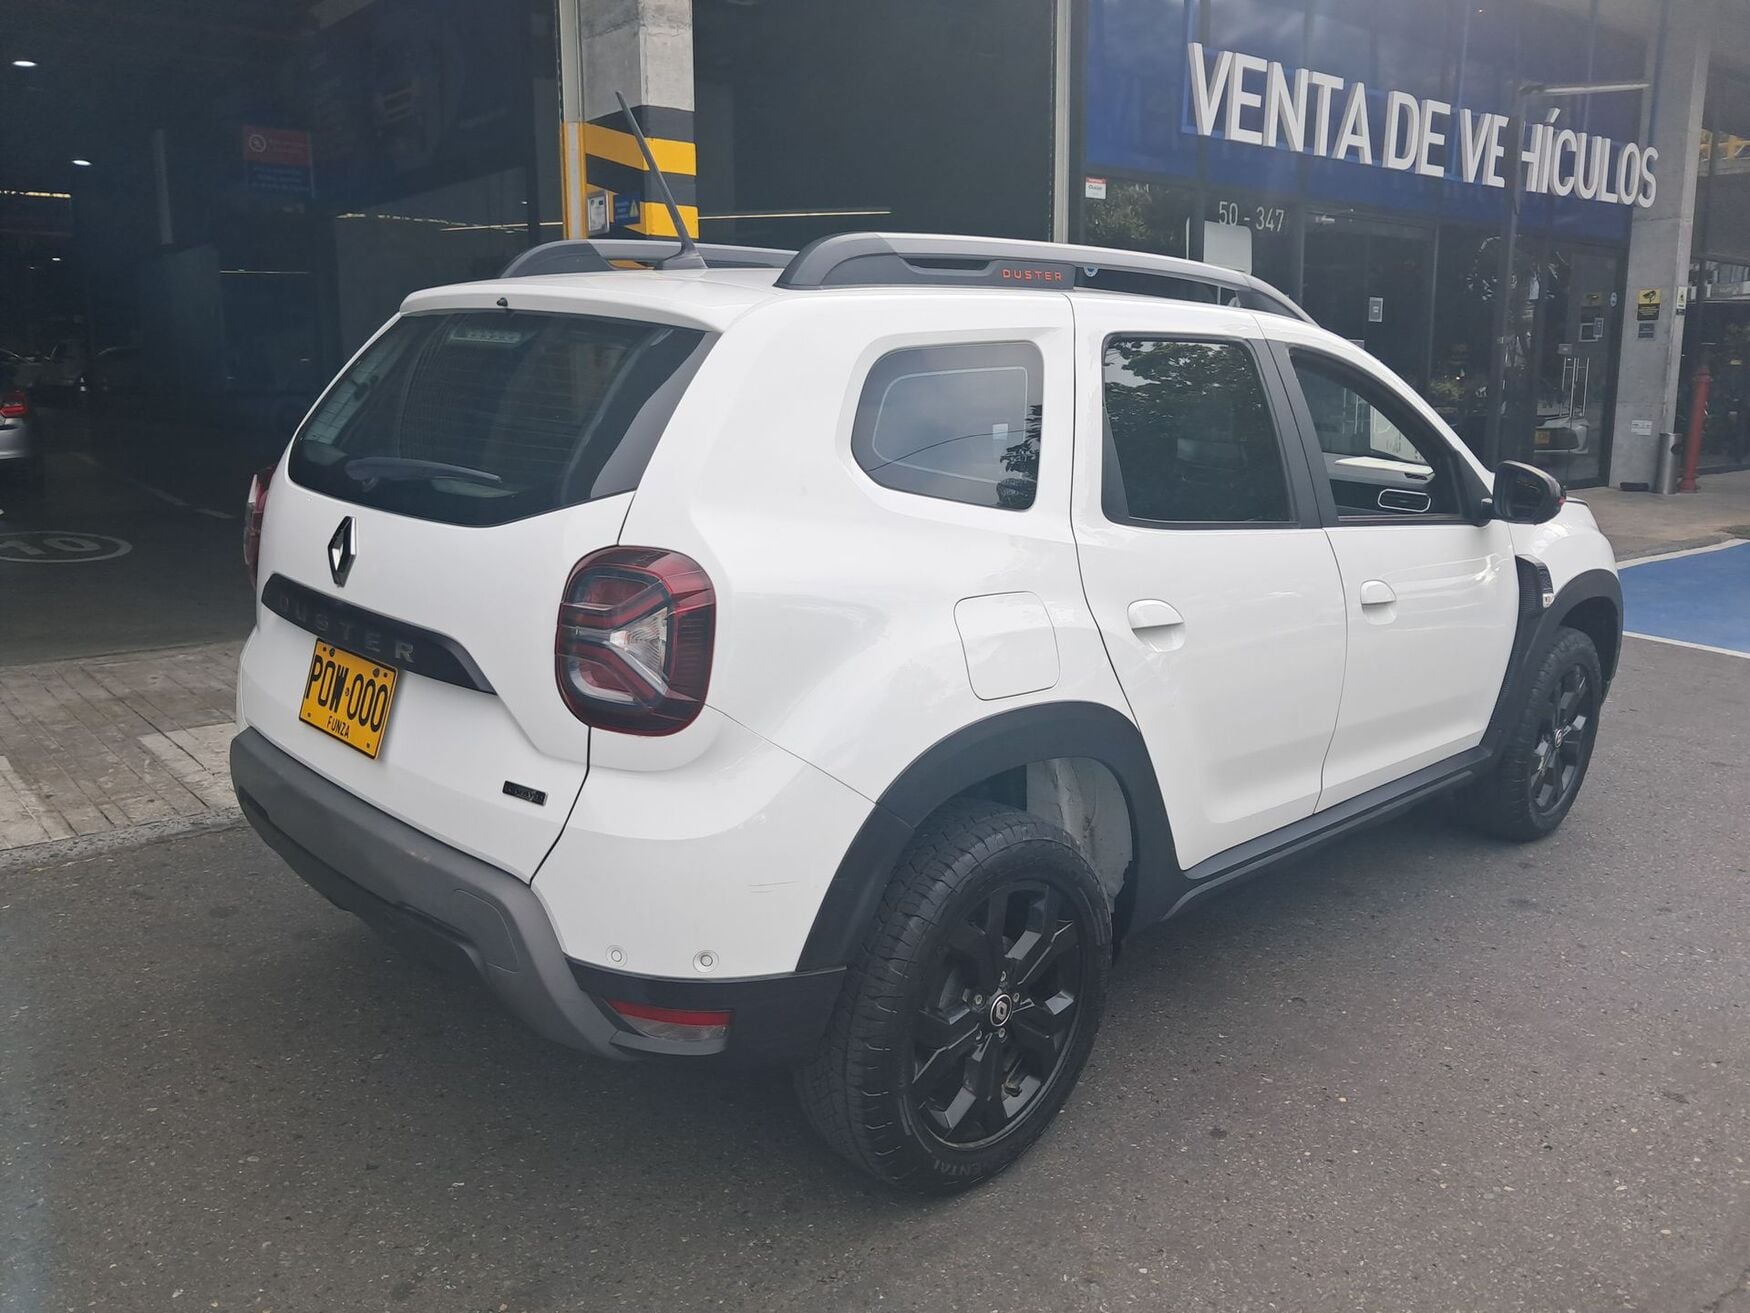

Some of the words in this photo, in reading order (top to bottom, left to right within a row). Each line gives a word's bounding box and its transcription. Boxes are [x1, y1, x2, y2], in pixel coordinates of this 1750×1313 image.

[1188, 42, 1373, 165] VENTA
[1383, 89, 1451, 178] DE
[1218, 201, 1239, 226] 50
[1255, 206, 1286, 232] 347
[1001, 268, 1063, 282] DUSTER
[279, 597, 415, 663] DUSTER
[326, 715, 350, 739] FUNZA
